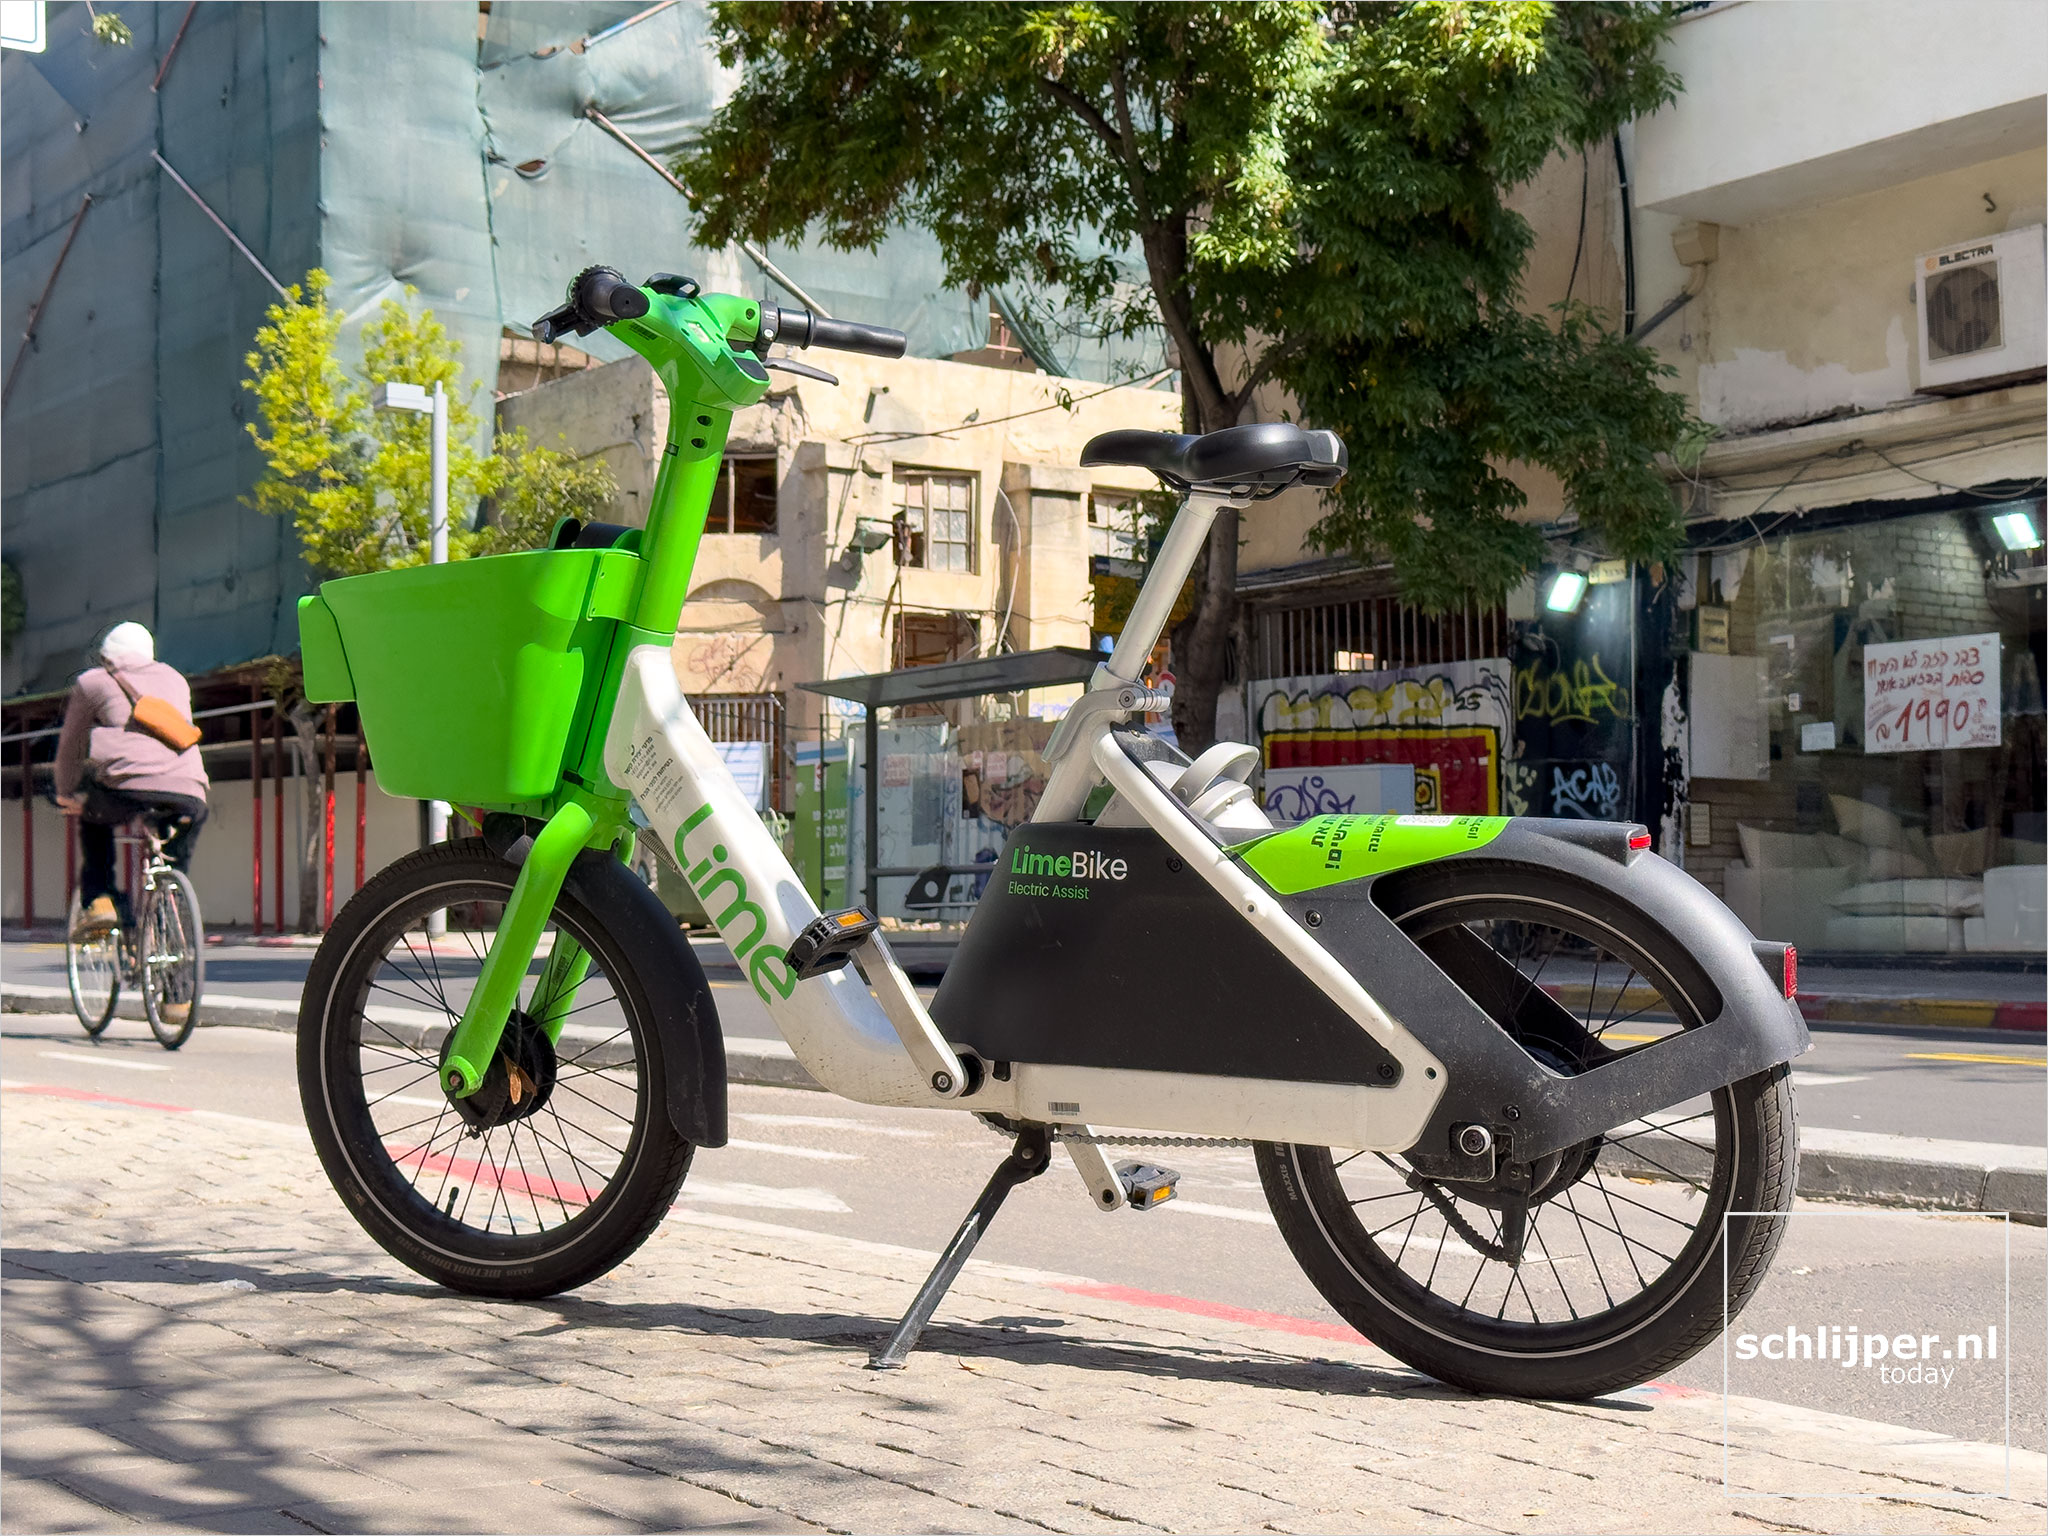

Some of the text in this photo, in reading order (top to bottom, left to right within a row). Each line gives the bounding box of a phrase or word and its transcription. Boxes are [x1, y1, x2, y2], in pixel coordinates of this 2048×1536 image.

[1939, 244, 1994, 266] ELECTRA
[1953, 647, 1980, 667] דבר
[1895, 698, 1969, 744] 1990
[1551, 762, 1620, 802] ACAB
[1011, 845, 1128, 881] LimeBike
[674, 802, 798, 1006] Lime
[1008, 881, 1090, 900] Electric Assist
[1280, 1164, 1298, 1200] MAXXIS
